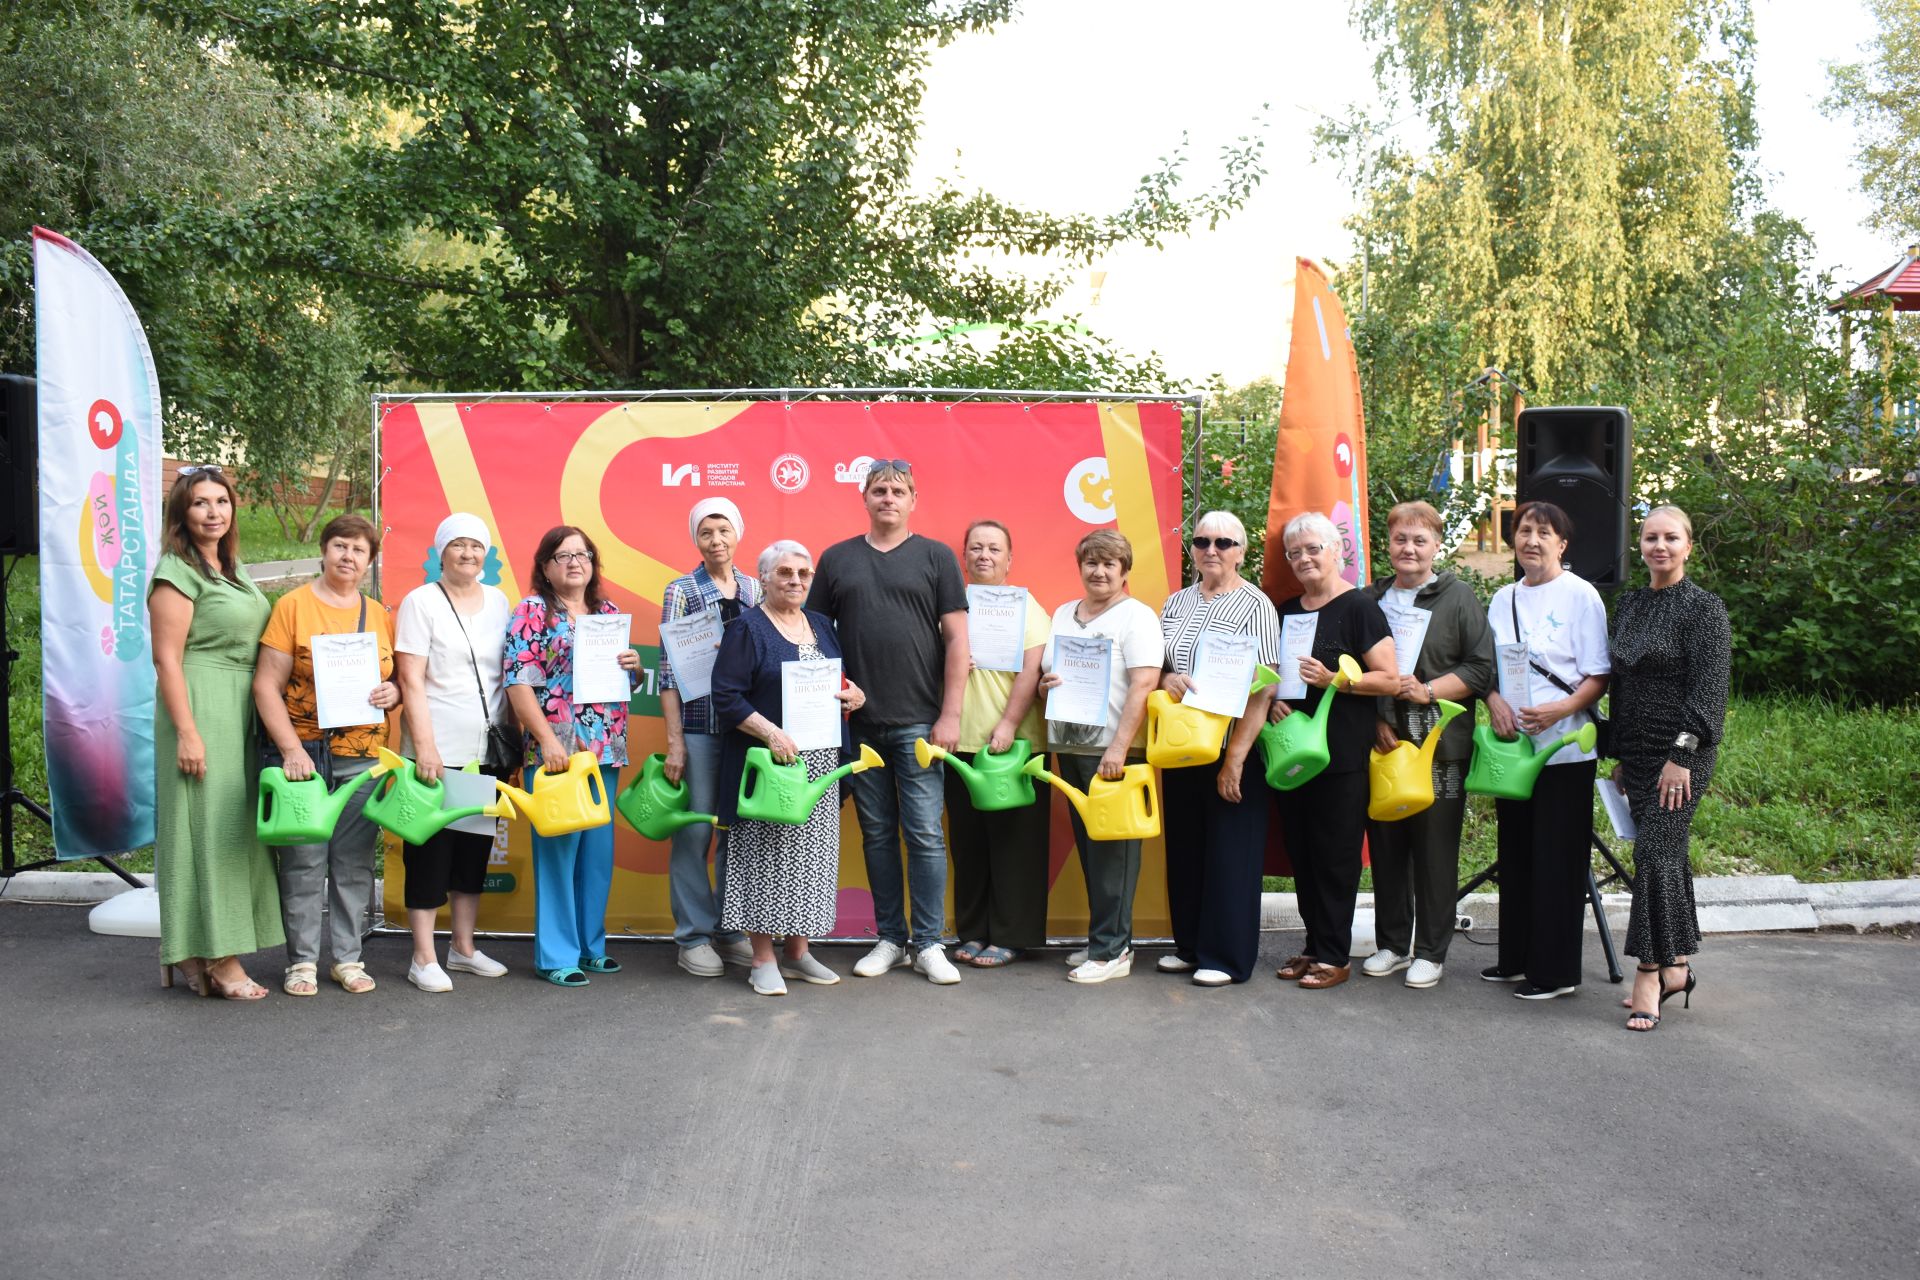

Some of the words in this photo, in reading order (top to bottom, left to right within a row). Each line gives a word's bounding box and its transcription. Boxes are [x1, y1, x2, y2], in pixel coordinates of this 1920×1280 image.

[119, 452, 141, 632] ТАТАРСТАНДА
[977, 607, 1015, 617] ПИСЬМО
[585, 638, 619, 647] ПИСЬМО
[677, 631, 714, 648] ПИСЬМО
[1063, 659, 1100, 670] ПИСЬМО
[1208, 655, 1244, 665] ПИСЬМО
[794, 684, 831, 694] ПИСЬМО
